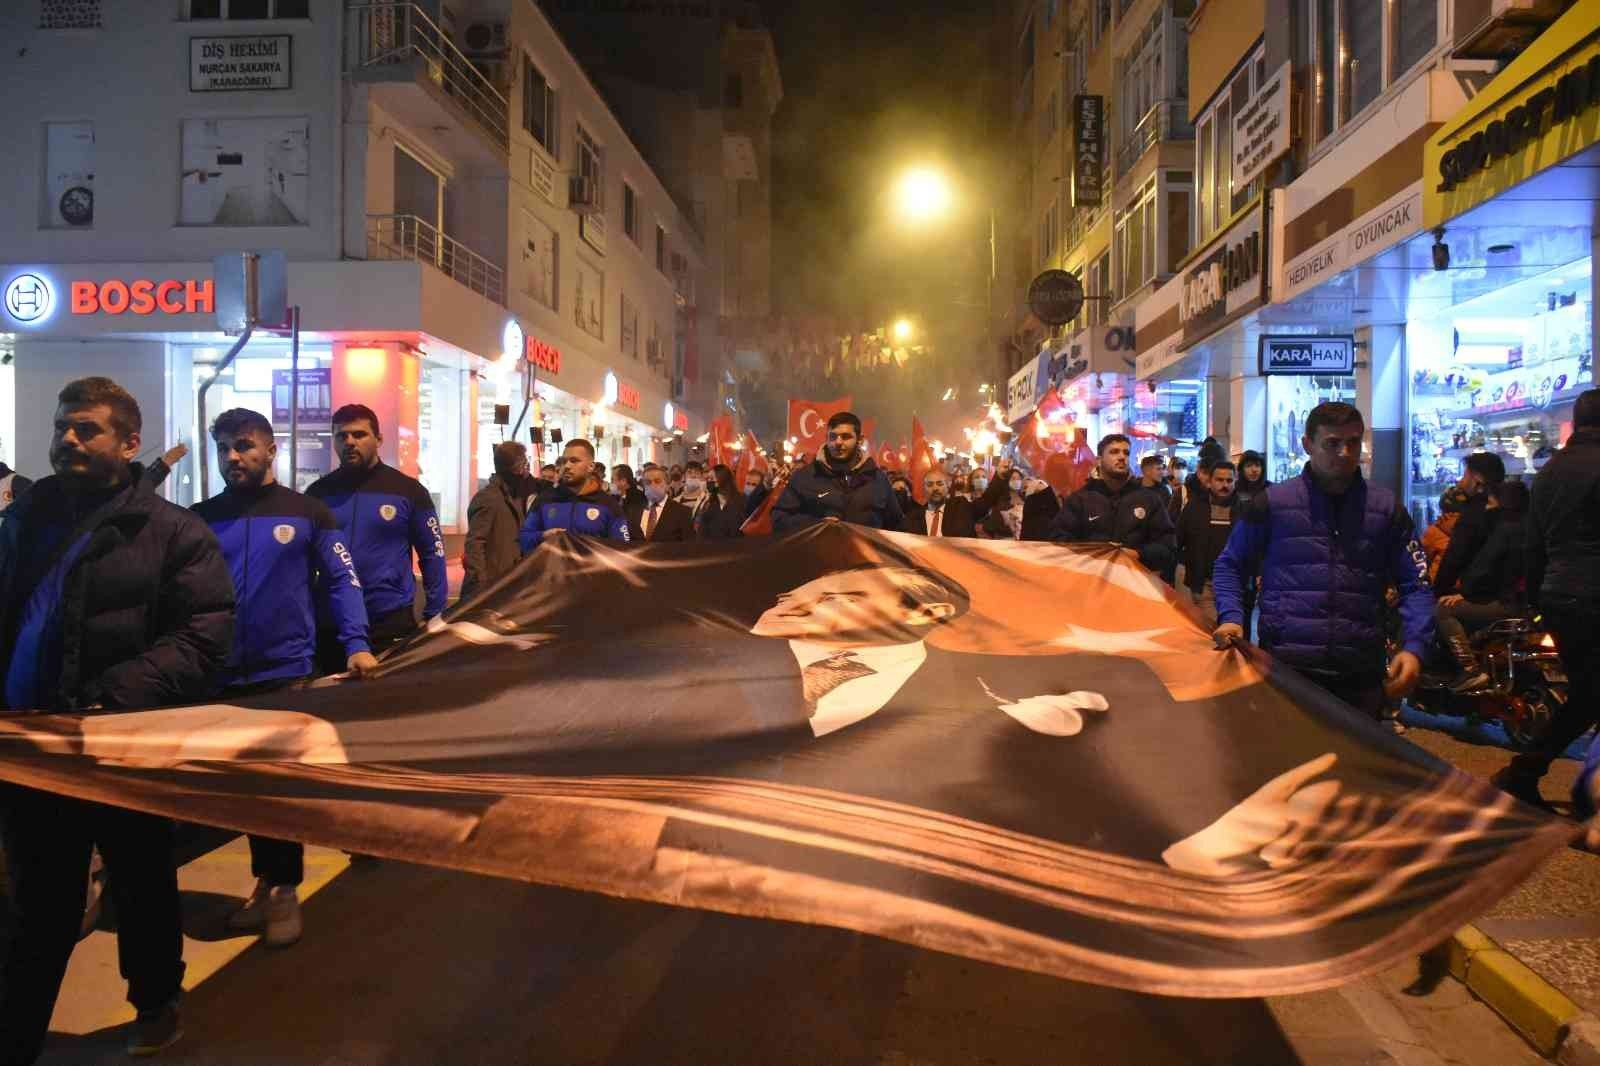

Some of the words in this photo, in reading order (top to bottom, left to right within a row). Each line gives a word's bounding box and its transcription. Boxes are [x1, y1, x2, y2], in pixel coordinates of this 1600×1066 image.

[201, 42, 224, 60] DİŞ
[230, 40, 279, 56] HEKİMİ
[1354, 203, 1411, 250] OYUNCAK
[71, 280, 216, 314] BOSCH
[526, 335, 562, 374] BOSCH
[1271, 349, 1344, 361] KARAHAN
